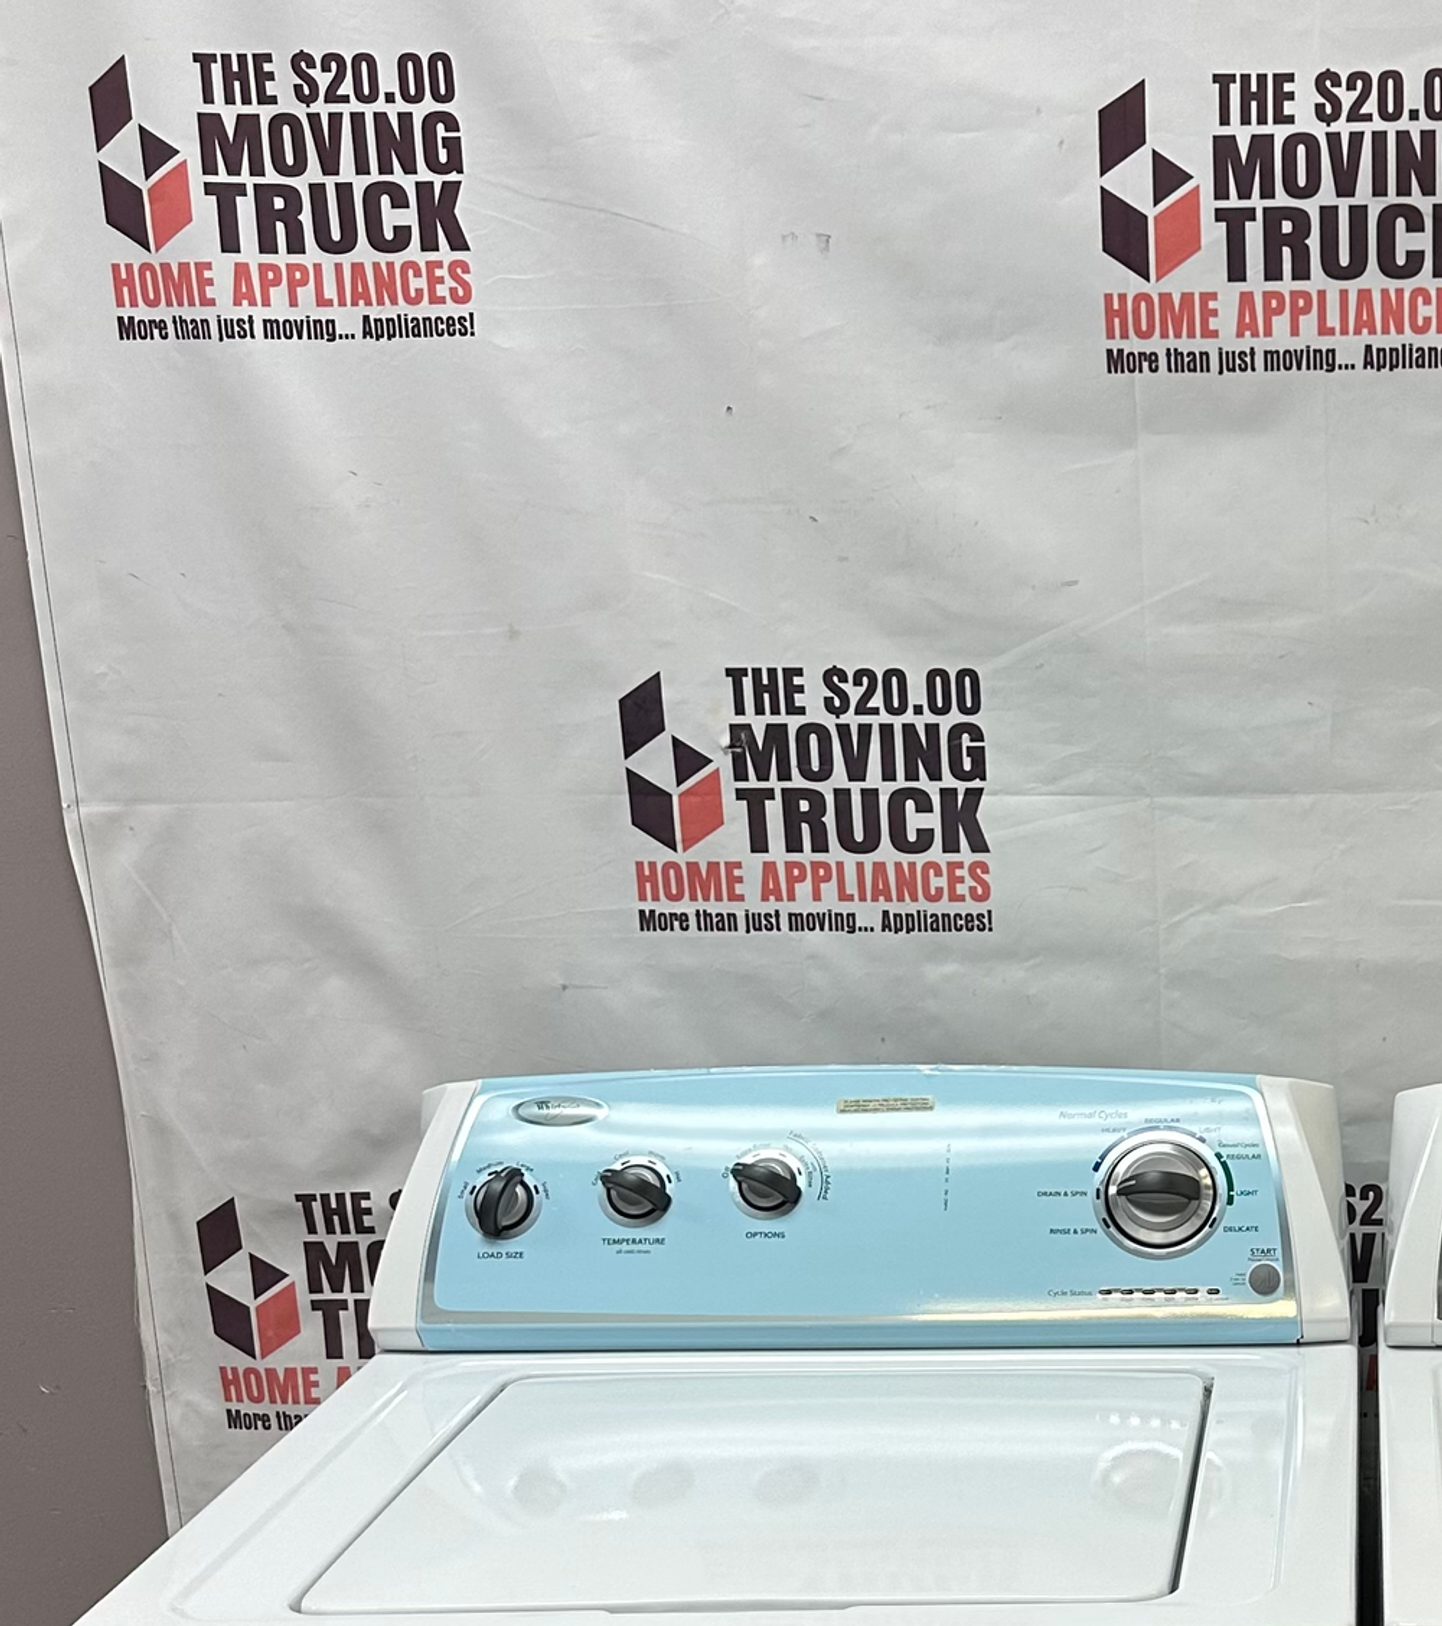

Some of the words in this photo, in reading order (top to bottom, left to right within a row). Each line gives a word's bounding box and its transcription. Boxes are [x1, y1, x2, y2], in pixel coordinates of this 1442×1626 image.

[192, 53, 278, 105] THE
[291, 50, 455, 107] $20.00
[1213, 73, 1295, 126] THE
[197, 111, 463, 177] MOVING
[204, 181, 470, 254] TRUCK
[112, 262, 215, 308] HOME
[233, 260, 472, 307] APPLIANCES
[117, 316, 168, 340] More
[172, 315, 211, 340] than
[217, 315, 255, 342] just
[263, 316, 355, 342] moving...
[363, 312, 475, 341] Appliances!
[1105, 292, 1218, 339] HOME
[1106, 349, 1159, 374] More
[1166, 348, 1210, 373] than
[1218, 347, 1256, 375] just
[1264, 345, 1355, 372] moving...
[725, 668, 806, 716] THE
[823, 665, 981, 719] $20.00
[727, 722, 986, 782] MOVING
[735, 787, 990, 854] TRUCK
[637, 862, 744, 901] HOME
[761, 861, 990, 902] APPLIANCES
[639, 909, 689, 931] More
[695, 909, 738, 932] than
[745, 909, 781, 934] just
[788, 909, 874, 934] moving...
[881, 910, 993, 934] Appliances!
[1058, 1110, 1096, 1120] Normal
[1098, 1110, 1128, 1121] Cycles
[294, 1191, 376, 1236] THE
[1037, 1190, 1064, 1198] DRAIN
[1065, 1190, 1070, 1198] &
[1072, 1190, 1088, 1198] SPIN
[601, 1237, 666, 1246] TEMPERATURE
[745, 1231, 786, 1240] OPTIONS
[1250, 1248, 1277, 1256] START
[477, 1251, 503, 1260] LOAD
[505, 1251, 524, 1260] SIZE
[1047, 1290, 1070, 1298] Cycle
[219, 1366, 321, 1405] HOME
[226, 1408, 272, 1430] More
